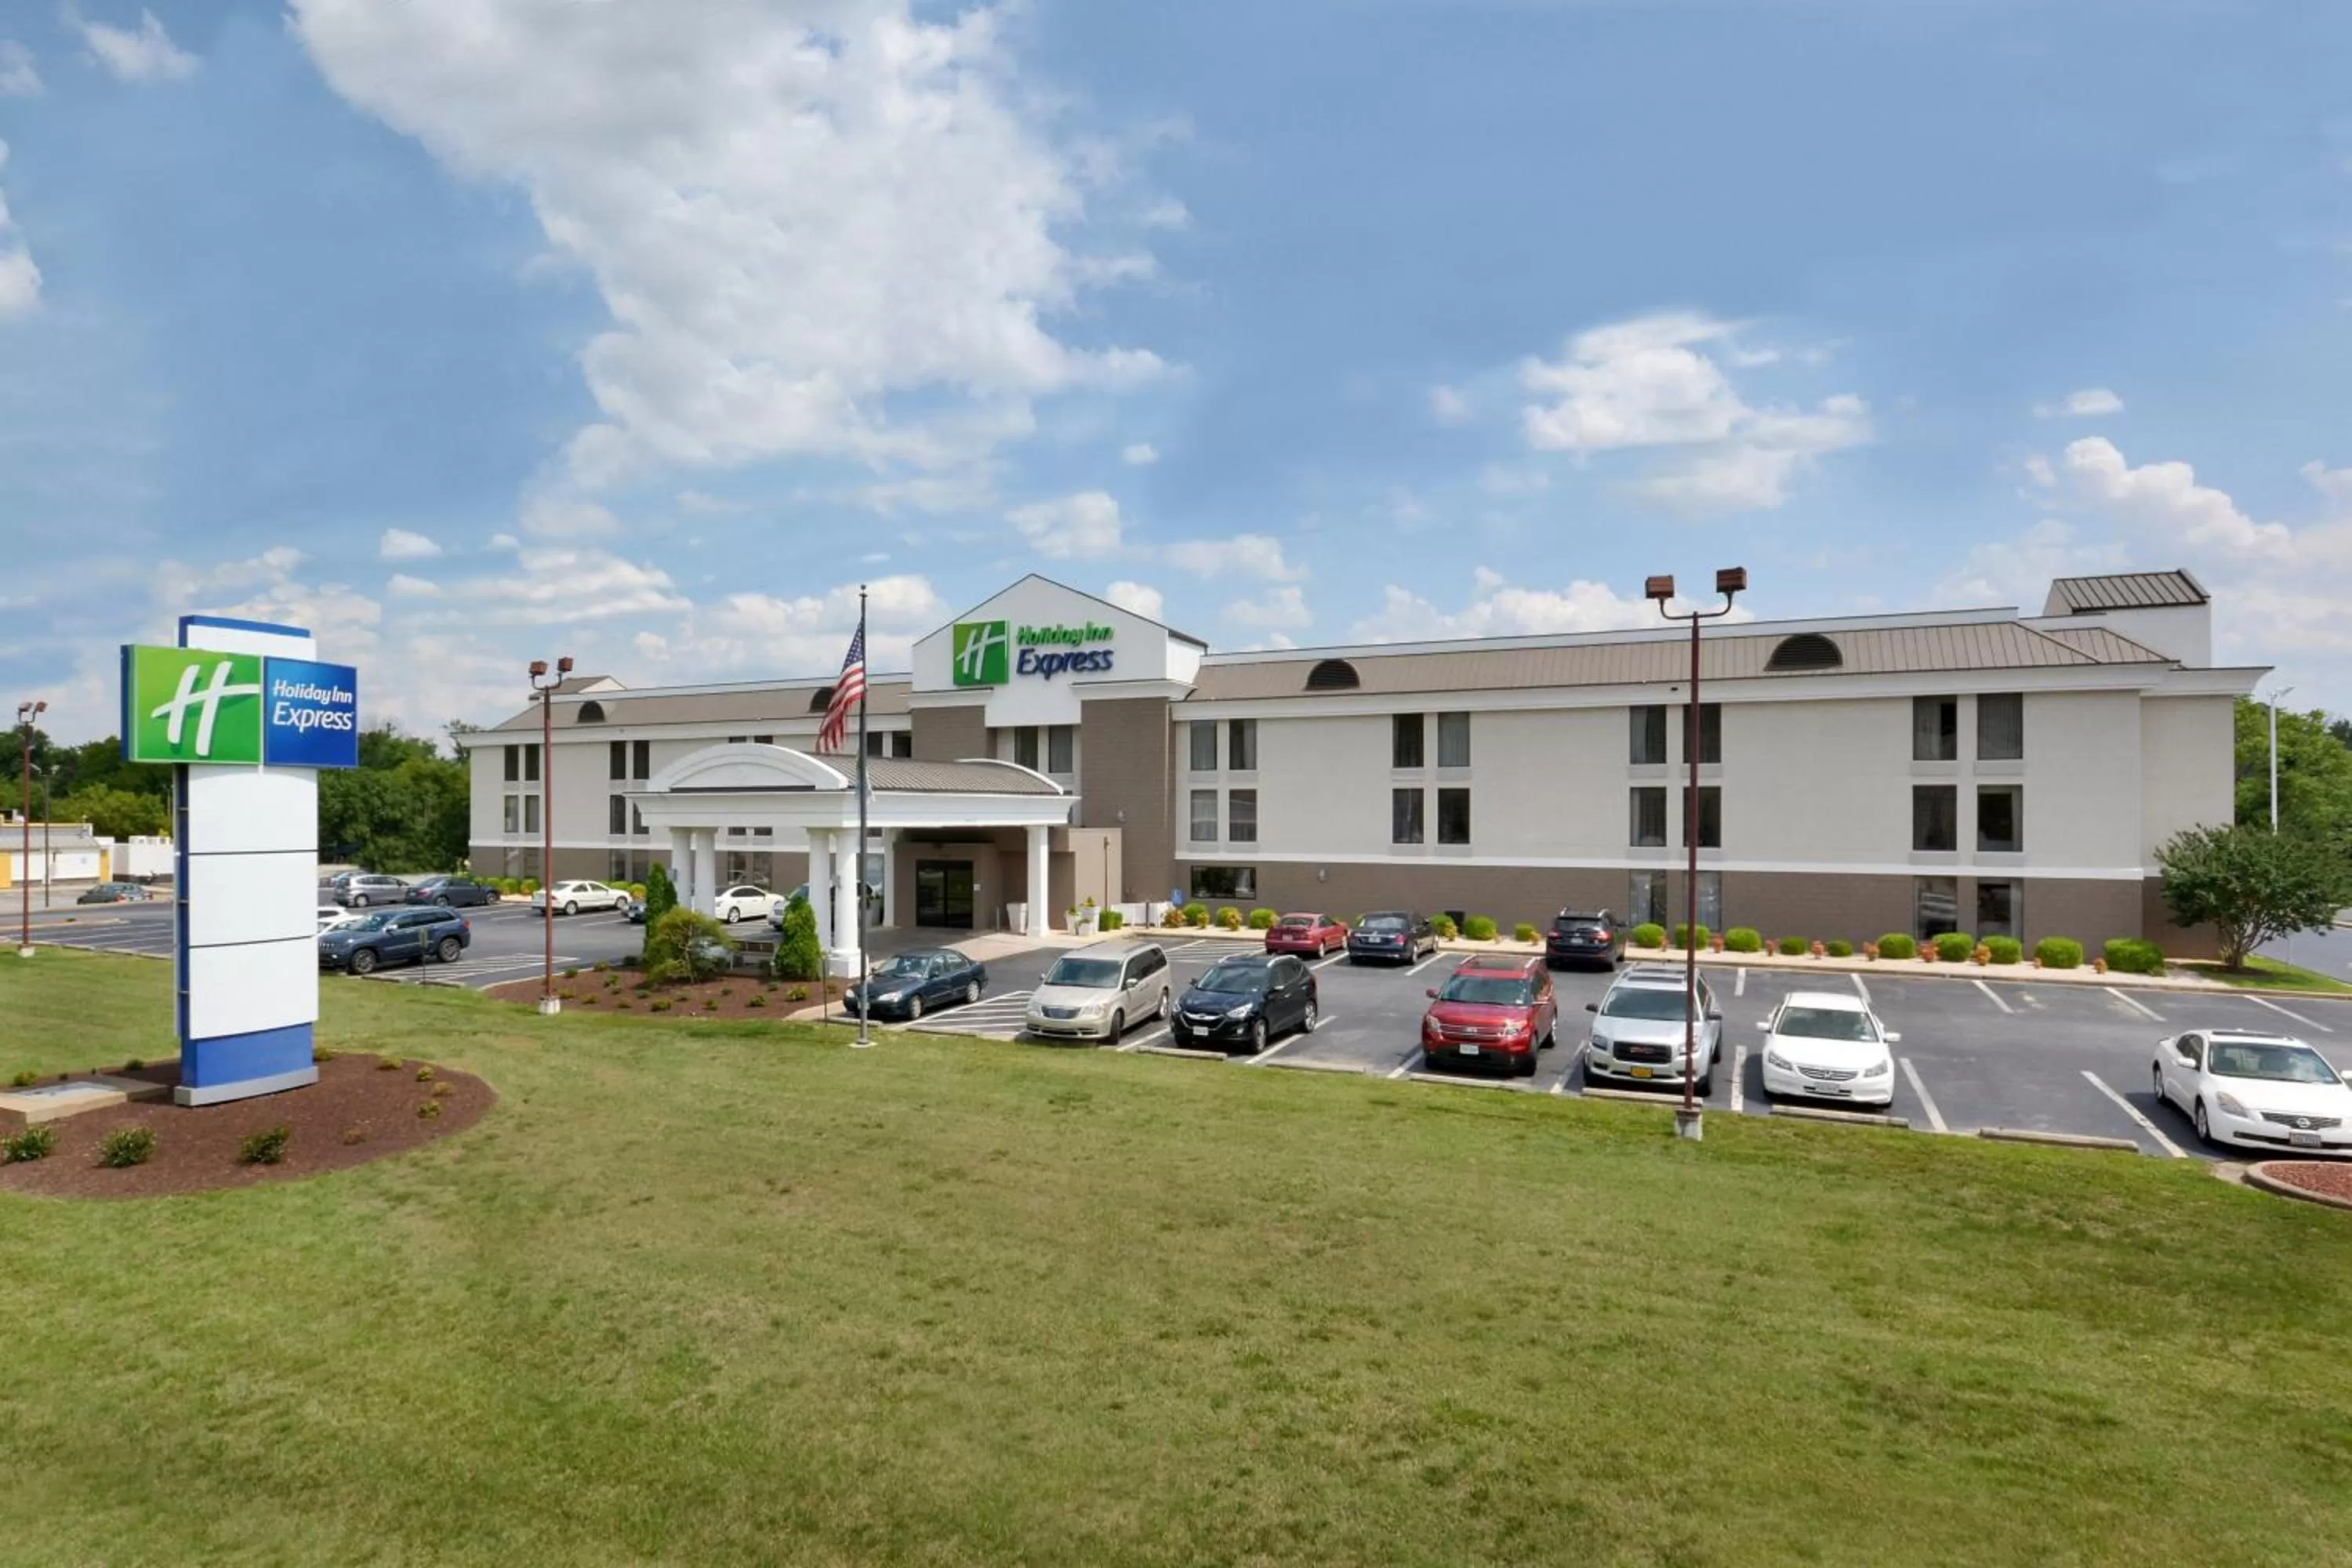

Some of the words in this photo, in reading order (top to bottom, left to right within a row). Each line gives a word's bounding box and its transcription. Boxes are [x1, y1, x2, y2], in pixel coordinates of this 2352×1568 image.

[1016, 623, 1083, 647] Holiday
[1084, 620, 1113, 641] Inn
[1016, 648, 1114, 681] Express
[273, 679, 331, 705] Holiday
[332, 684, 352, 703] Inn
[273, 702, 353, 733] Express
